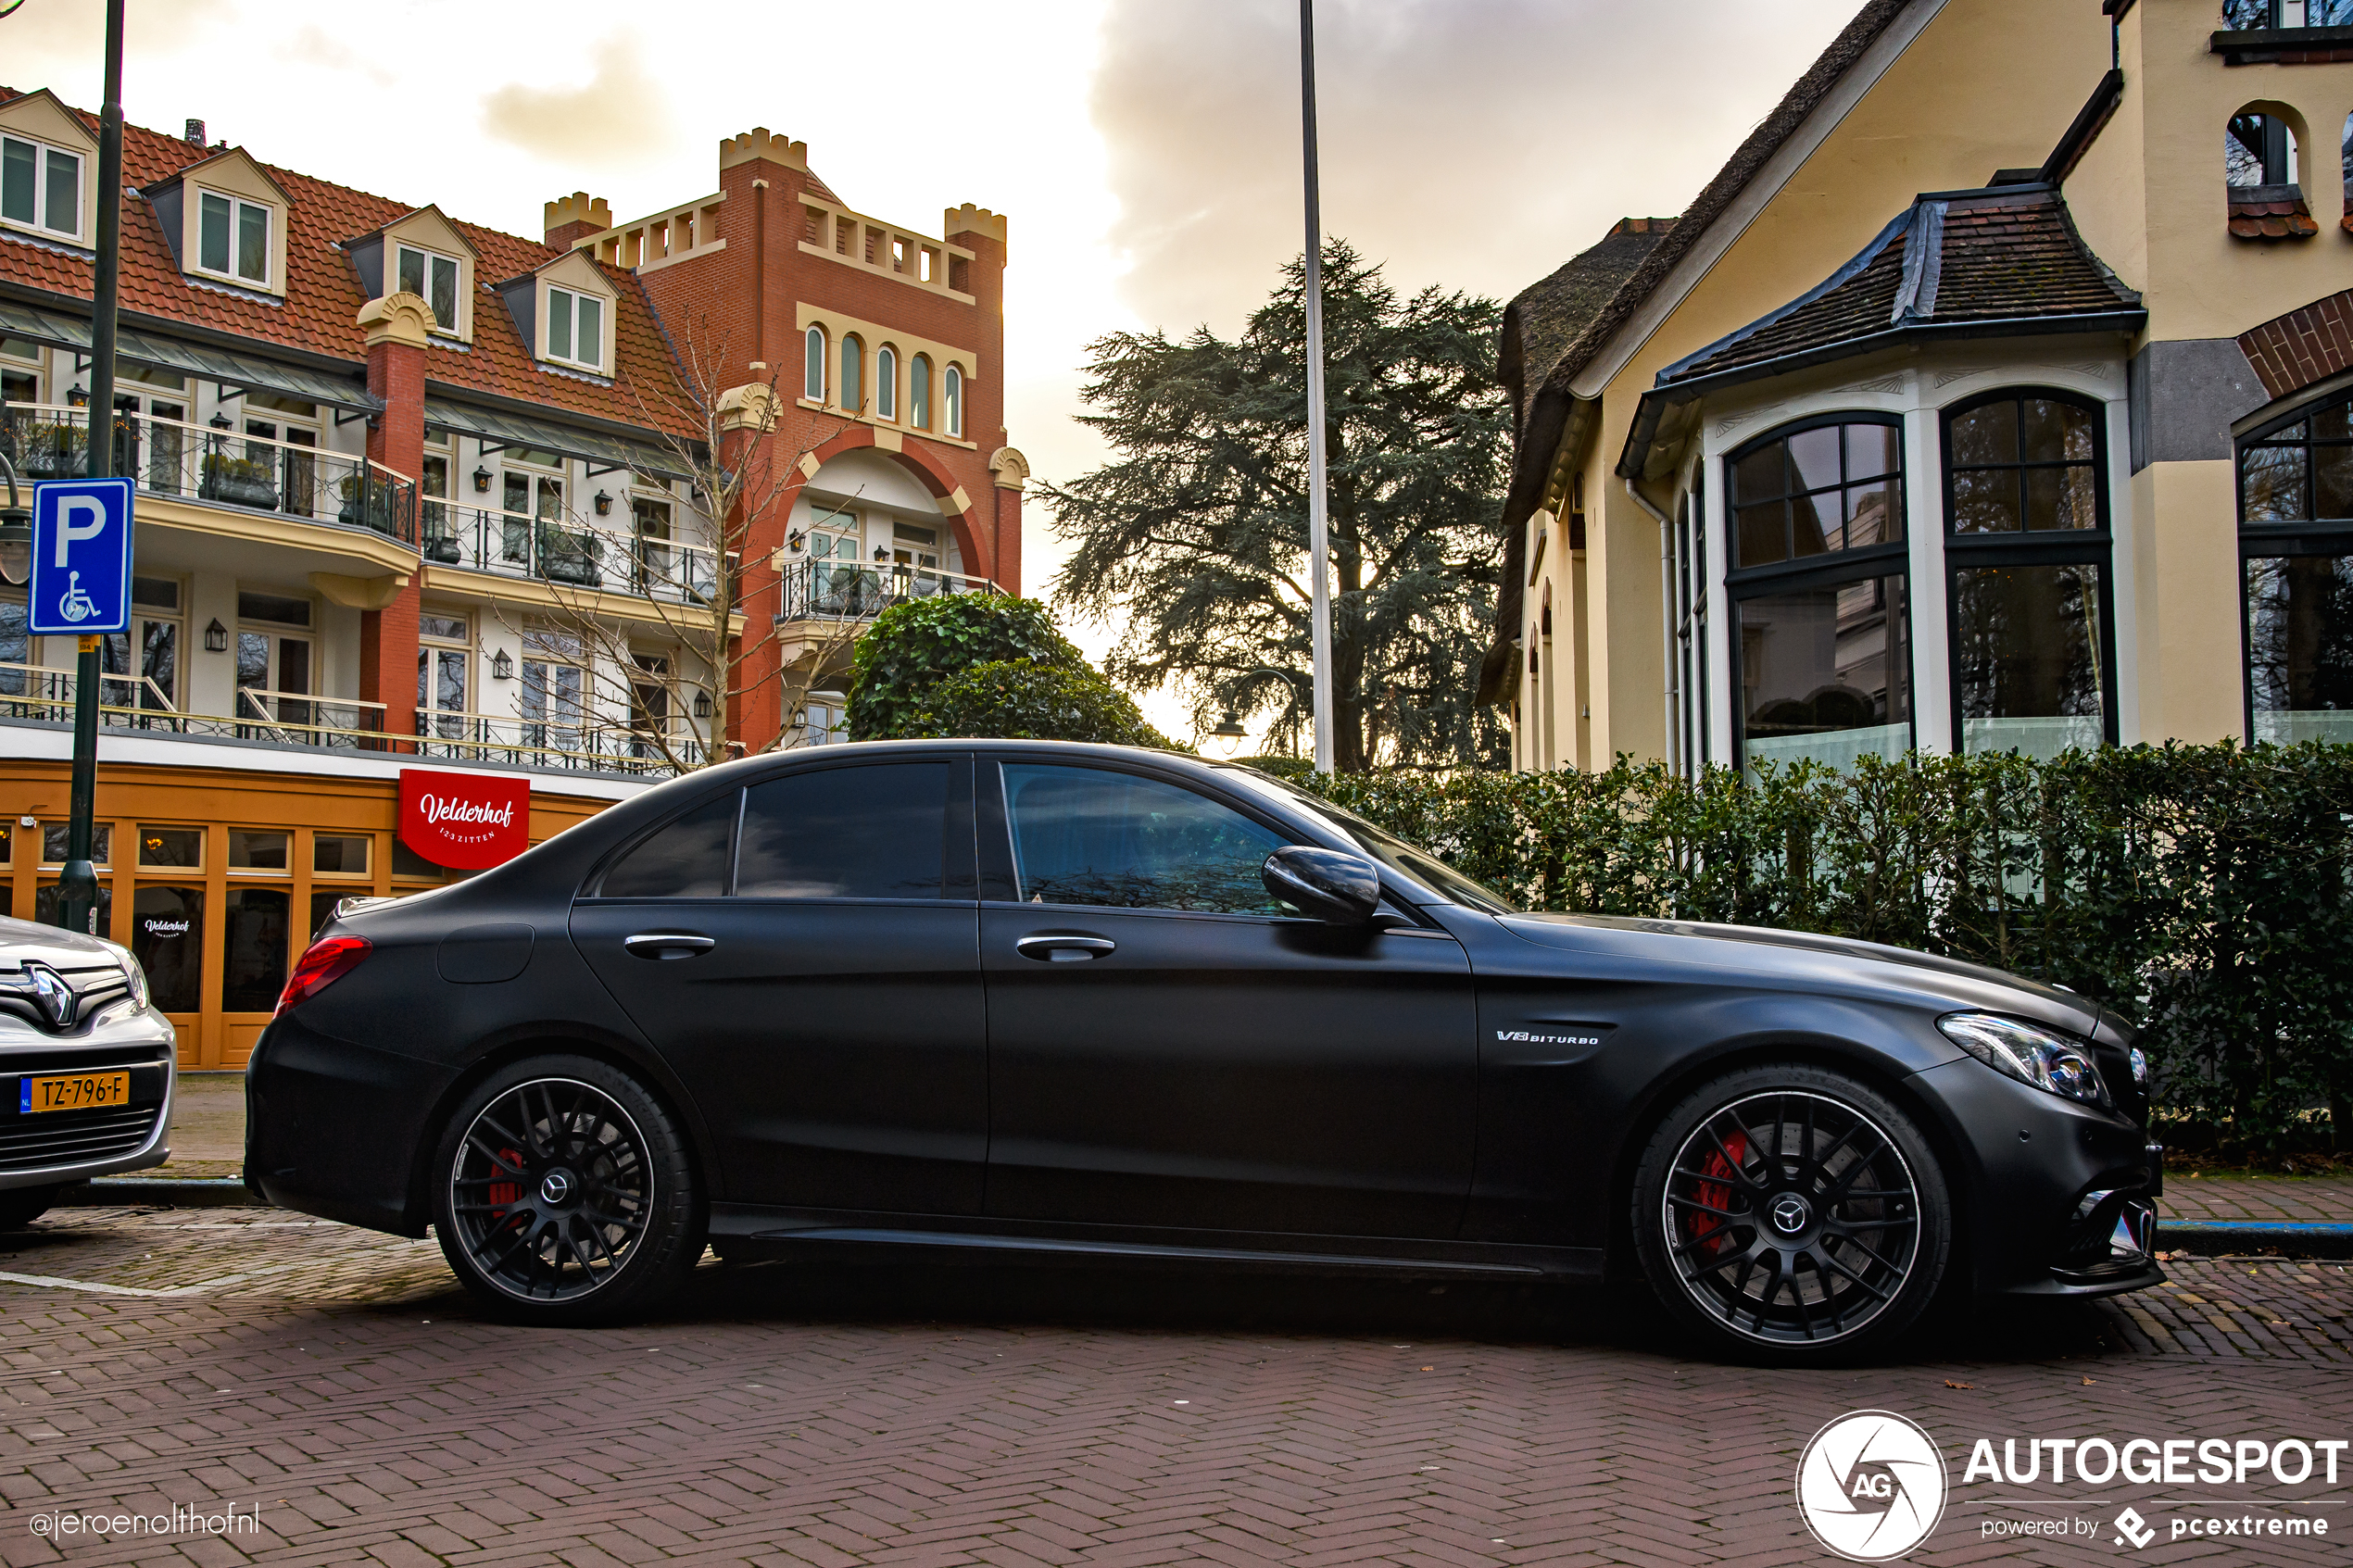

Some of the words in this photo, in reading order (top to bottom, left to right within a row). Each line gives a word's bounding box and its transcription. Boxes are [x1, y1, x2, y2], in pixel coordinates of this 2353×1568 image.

[55, 495, 107, 568] P
[420, 793, 514, 828] Velderhof
[457, 831, 495, 844] ZITTEN
[145, 919, 190, 932] Velderhof
[42, 1075, 122, 1106] TZ-796-F
[21, 1098, 31, 1107] NL
